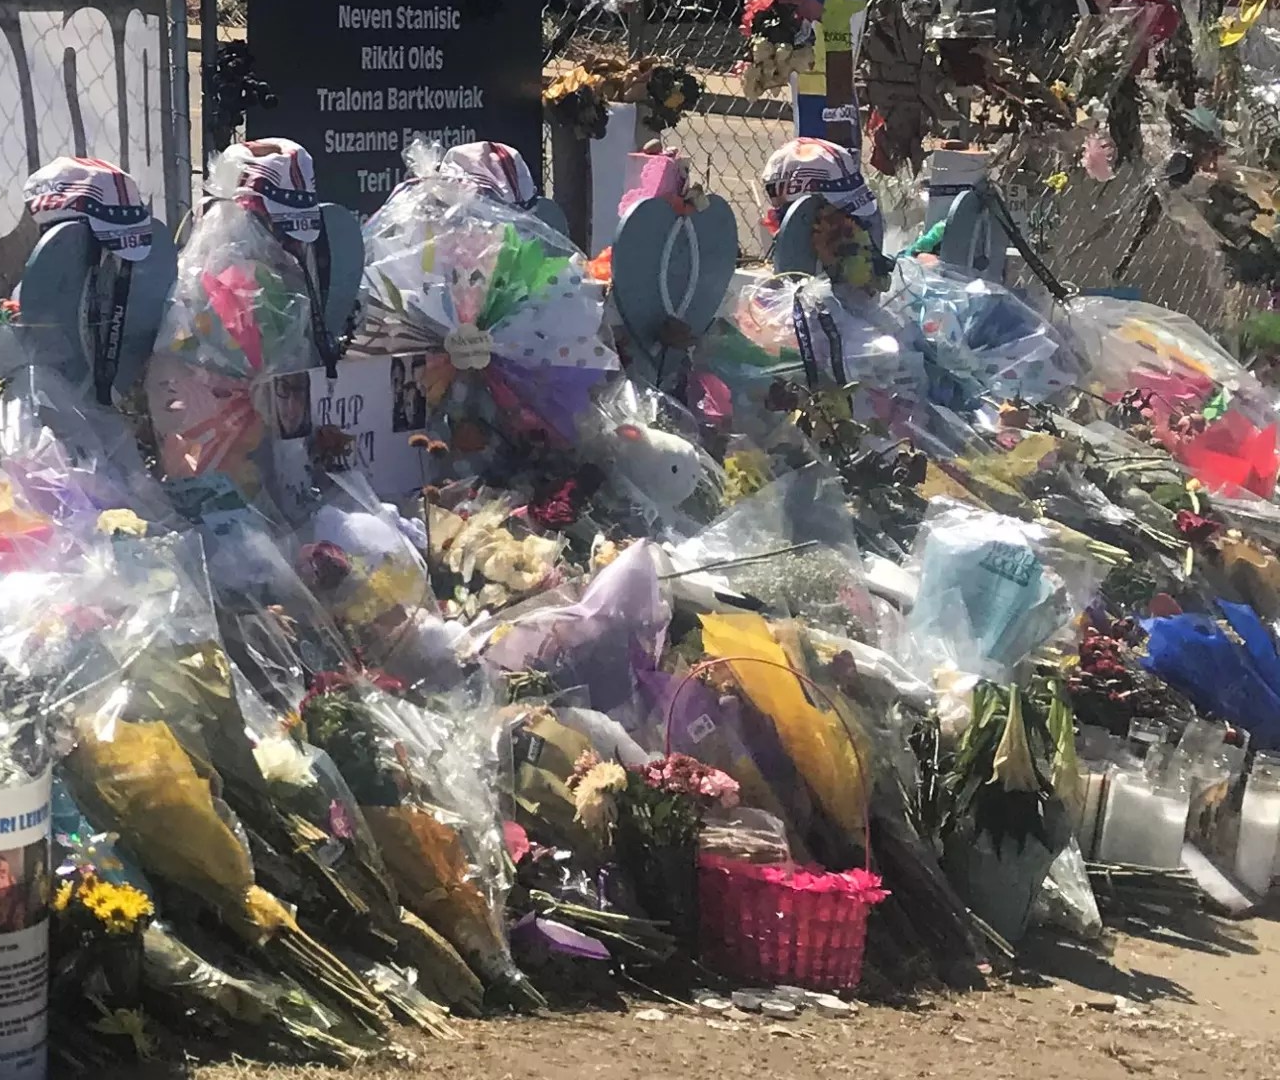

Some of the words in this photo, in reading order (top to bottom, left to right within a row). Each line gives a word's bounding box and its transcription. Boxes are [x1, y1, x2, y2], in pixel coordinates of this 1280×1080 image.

[338, 4, 393, 30] Neven
[396, 5, 461, 30] Stanisic
[361, 46, 404, 70] Rikki
[407, 46, 444, 70] Olds
[316, 87, 383, 112] Tralona
[387, 85, 484, 111] Bartkowiak
[324, 129, 399, 154] Suzanne
[357, 169, 390, 193] Teri
